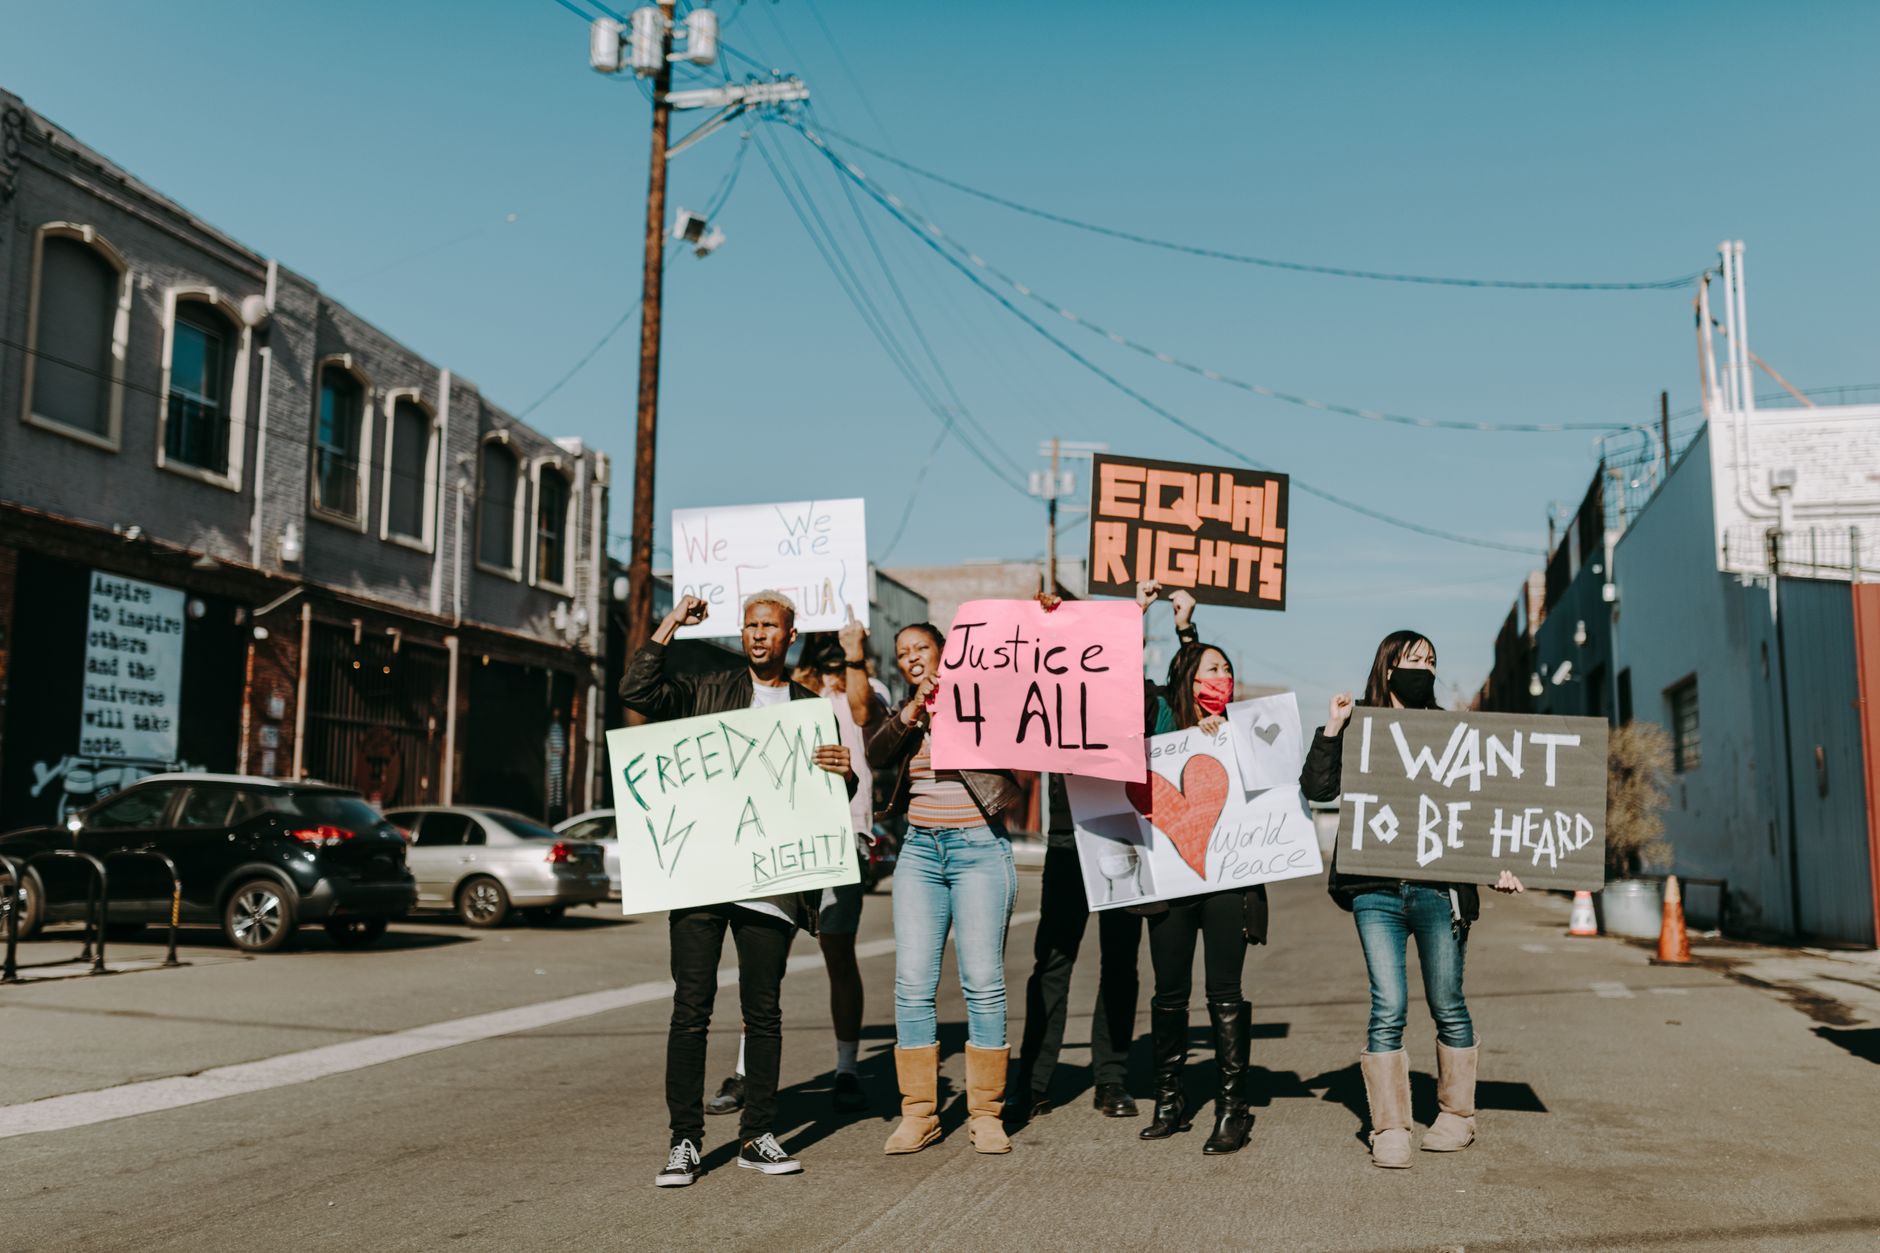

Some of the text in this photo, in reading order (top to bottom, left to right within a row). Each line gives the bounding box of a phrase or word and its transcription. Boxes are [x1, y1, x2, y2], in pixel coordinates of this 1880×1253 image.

[774, 500, 832, 536] We
[1098, 462, 1286, 544] EQUAL
[681, 515, 728, 564] We
[777, 535, 831, 556] are
[1093, 521, 1284, 601] RIGHTS
[93, 576, 152, 604] Aspire
[92, 604, 182, 635] to inspire
[88, 631, 149, 655] others
[944, 622, 1110, 675] Justice
[87, 657, 157, 681] and the
[85, 684, 165, 707] universe
[953, 680, 1109, 750] 4 ALL
[84, 710, 171, 733] will take
[623, 719, 833, 811] FREEDOM
[1359, 716, 1581, 792] I WANT
[645, 795, 766, 879] IS A
[1209, 812, 1296, 852] World
[1343, 792, 1594, 870] TO BE HEARD
[752, 826, 847, 884] RIGHT!
[1217, 848, 1315, 884] Peace
